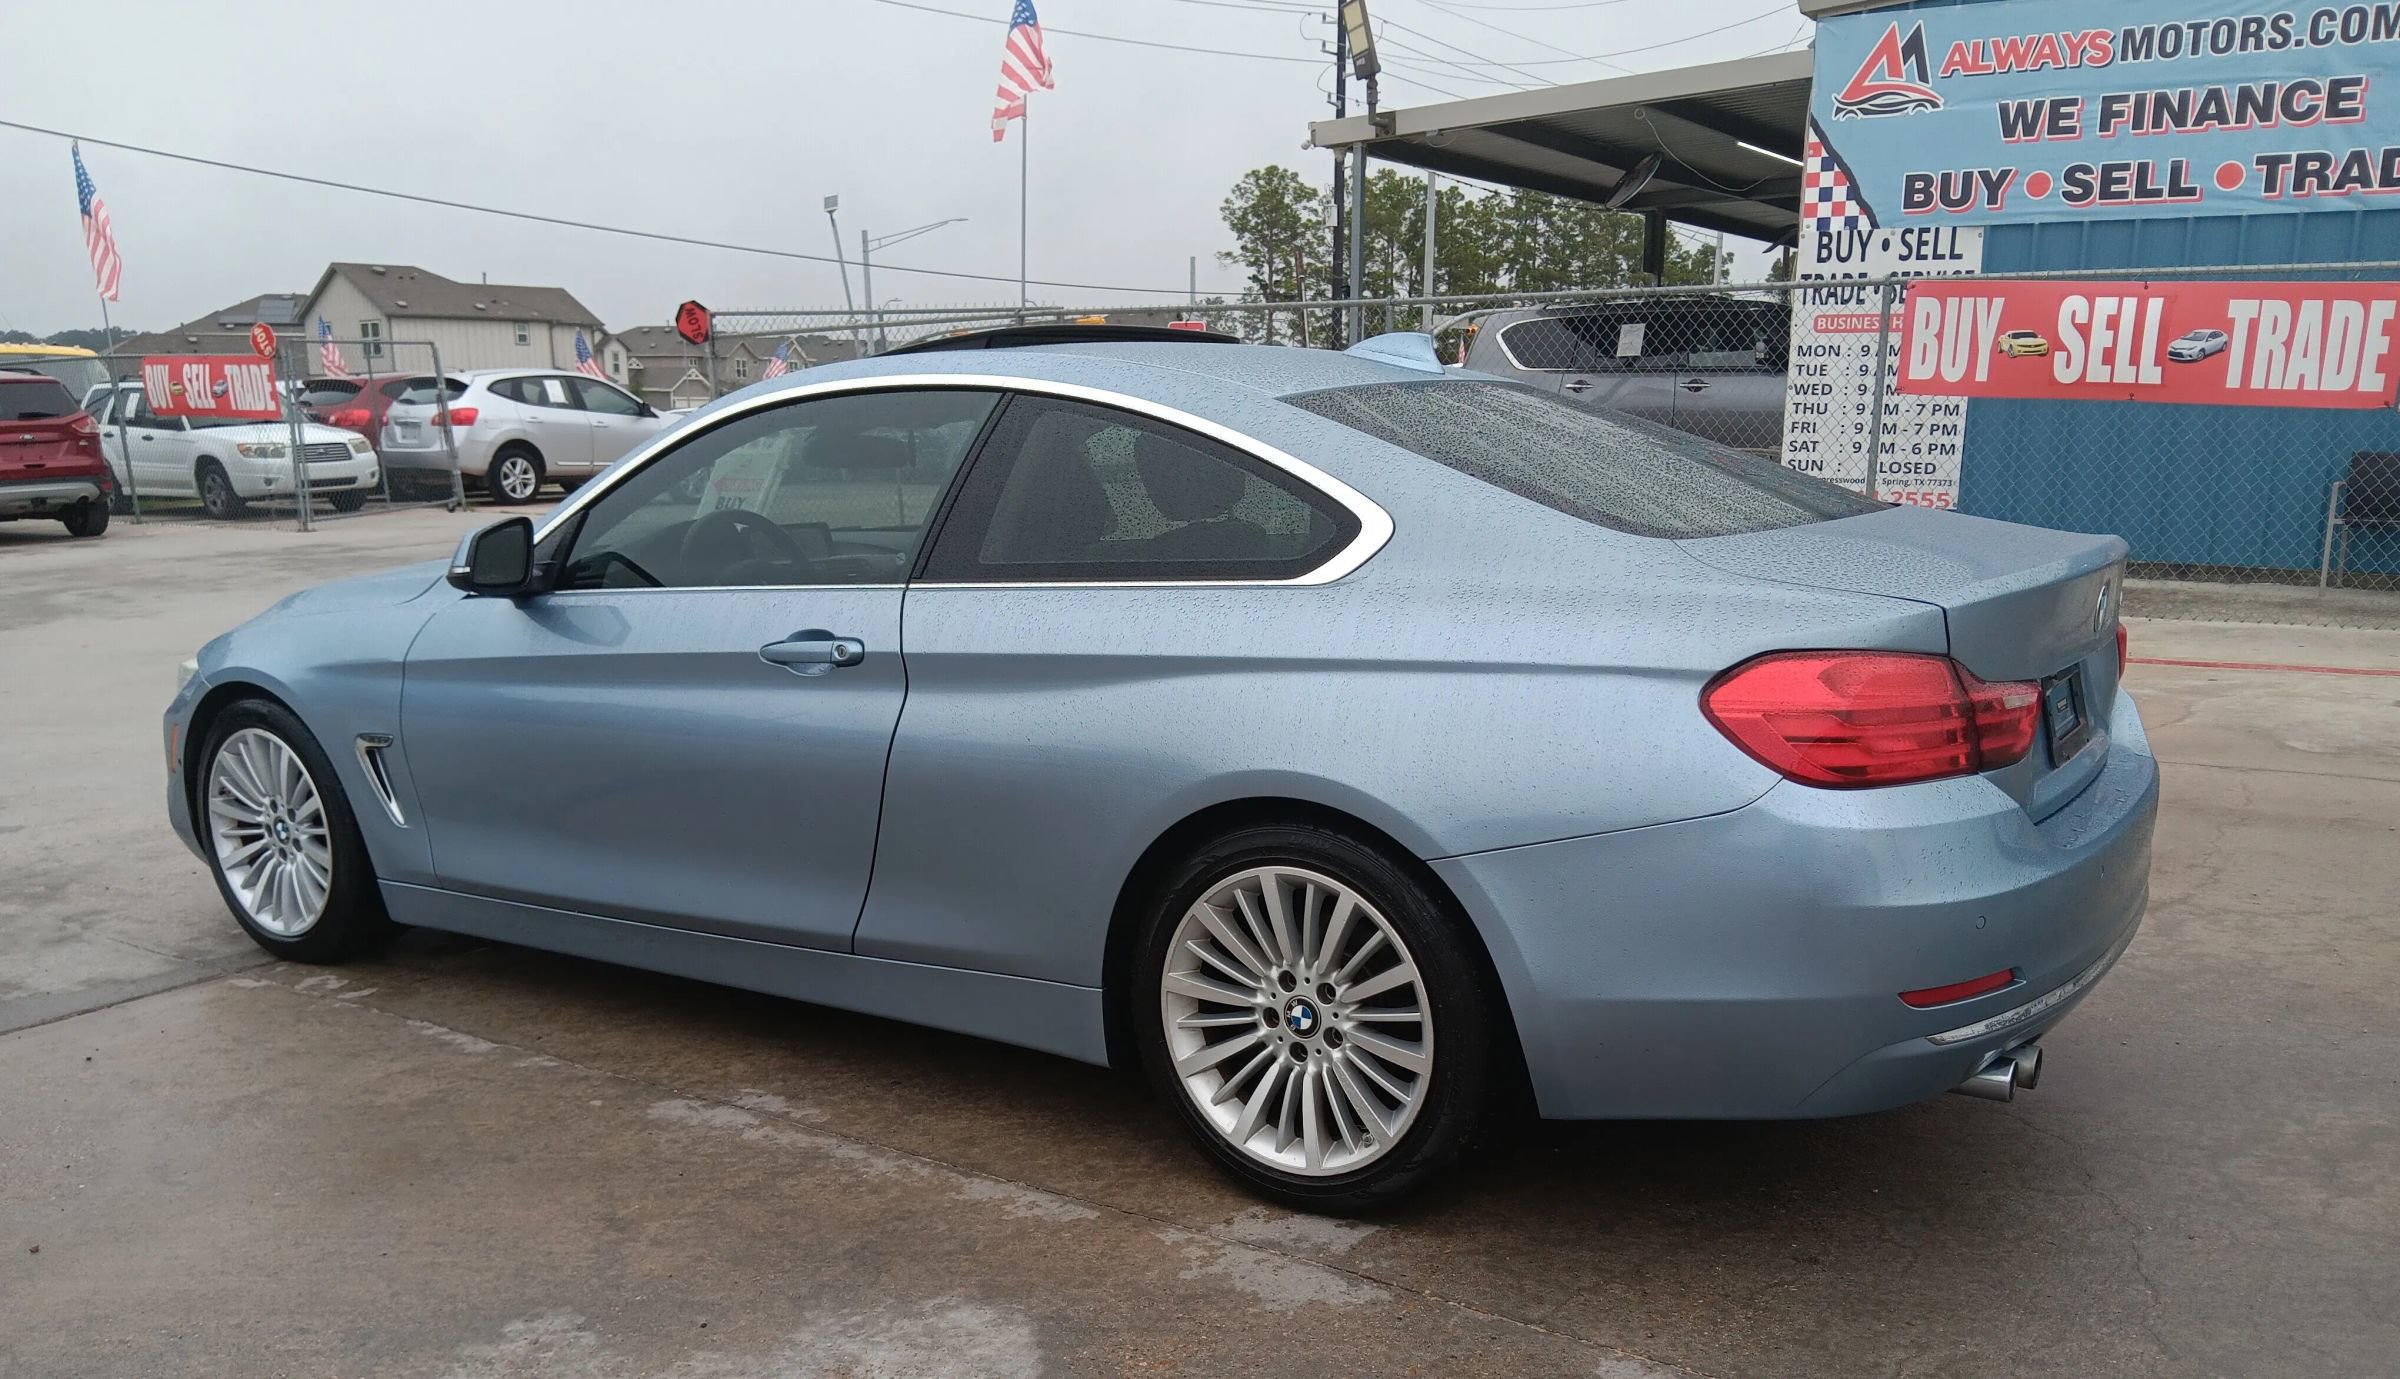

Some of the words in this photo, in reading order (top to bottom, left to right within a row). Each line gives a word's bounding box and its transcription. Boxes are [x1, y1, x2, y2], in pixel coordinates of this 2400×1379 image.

[1999, 97, 2083, 142] WE
[2098, 76, 2366, 138] FINANCE
[1902, 167, 2017, 214] BUY
[2060, 157, 2202, 207] SELL
[1817, 228, 1873, 263] BUY
[1899, 227, 1963, 261] SELL
[1801, 272, 1869, 305] TRADE
[1817, 317, 1880, 330] BUSINES
[254, 327, 272, 356] STOP
[1908, 296, 2004, 382] BUY
[2053, 295, 2164, 384] SELL
[2226, 299, 2396, 392] TRADE
[1797, 345, 1841, 357] MON
[1861, 345, 1870, 357] 9
[1796, 364, 1828, 377] TUE
[1859, 364, 1869, 376] 9
[145, 364, 174, 409] BUY
[183, 363, 216, 409] SELL
[224, 364, 276, 411] TRADE
[1794, 384, 1832, 395] WED
[1857, 384, 1867, 396] 9
[1793, 403, 1828, 414] THU
[1856, 403, 1865, 415] 9
[1916, 404, 1926, 416] 7
[1931, 404, 1960, 417] PM
[1791, 422, 1817, 433] FRI
[1854, 422, 1863, 434] 9
[1914, 424, 1924, 436] 7
[1930, 424, 1958, 436] PM
[1789, 441, 1819, 453] SAT
[1853, 442, 1862, 453] 9
[1912, 443, 1921, 455] 6
[1928, 443, 1955, 456] PM
[1788, 460, 1823, 471] SUN
[1879, 461, 1936, 474] LOSED
